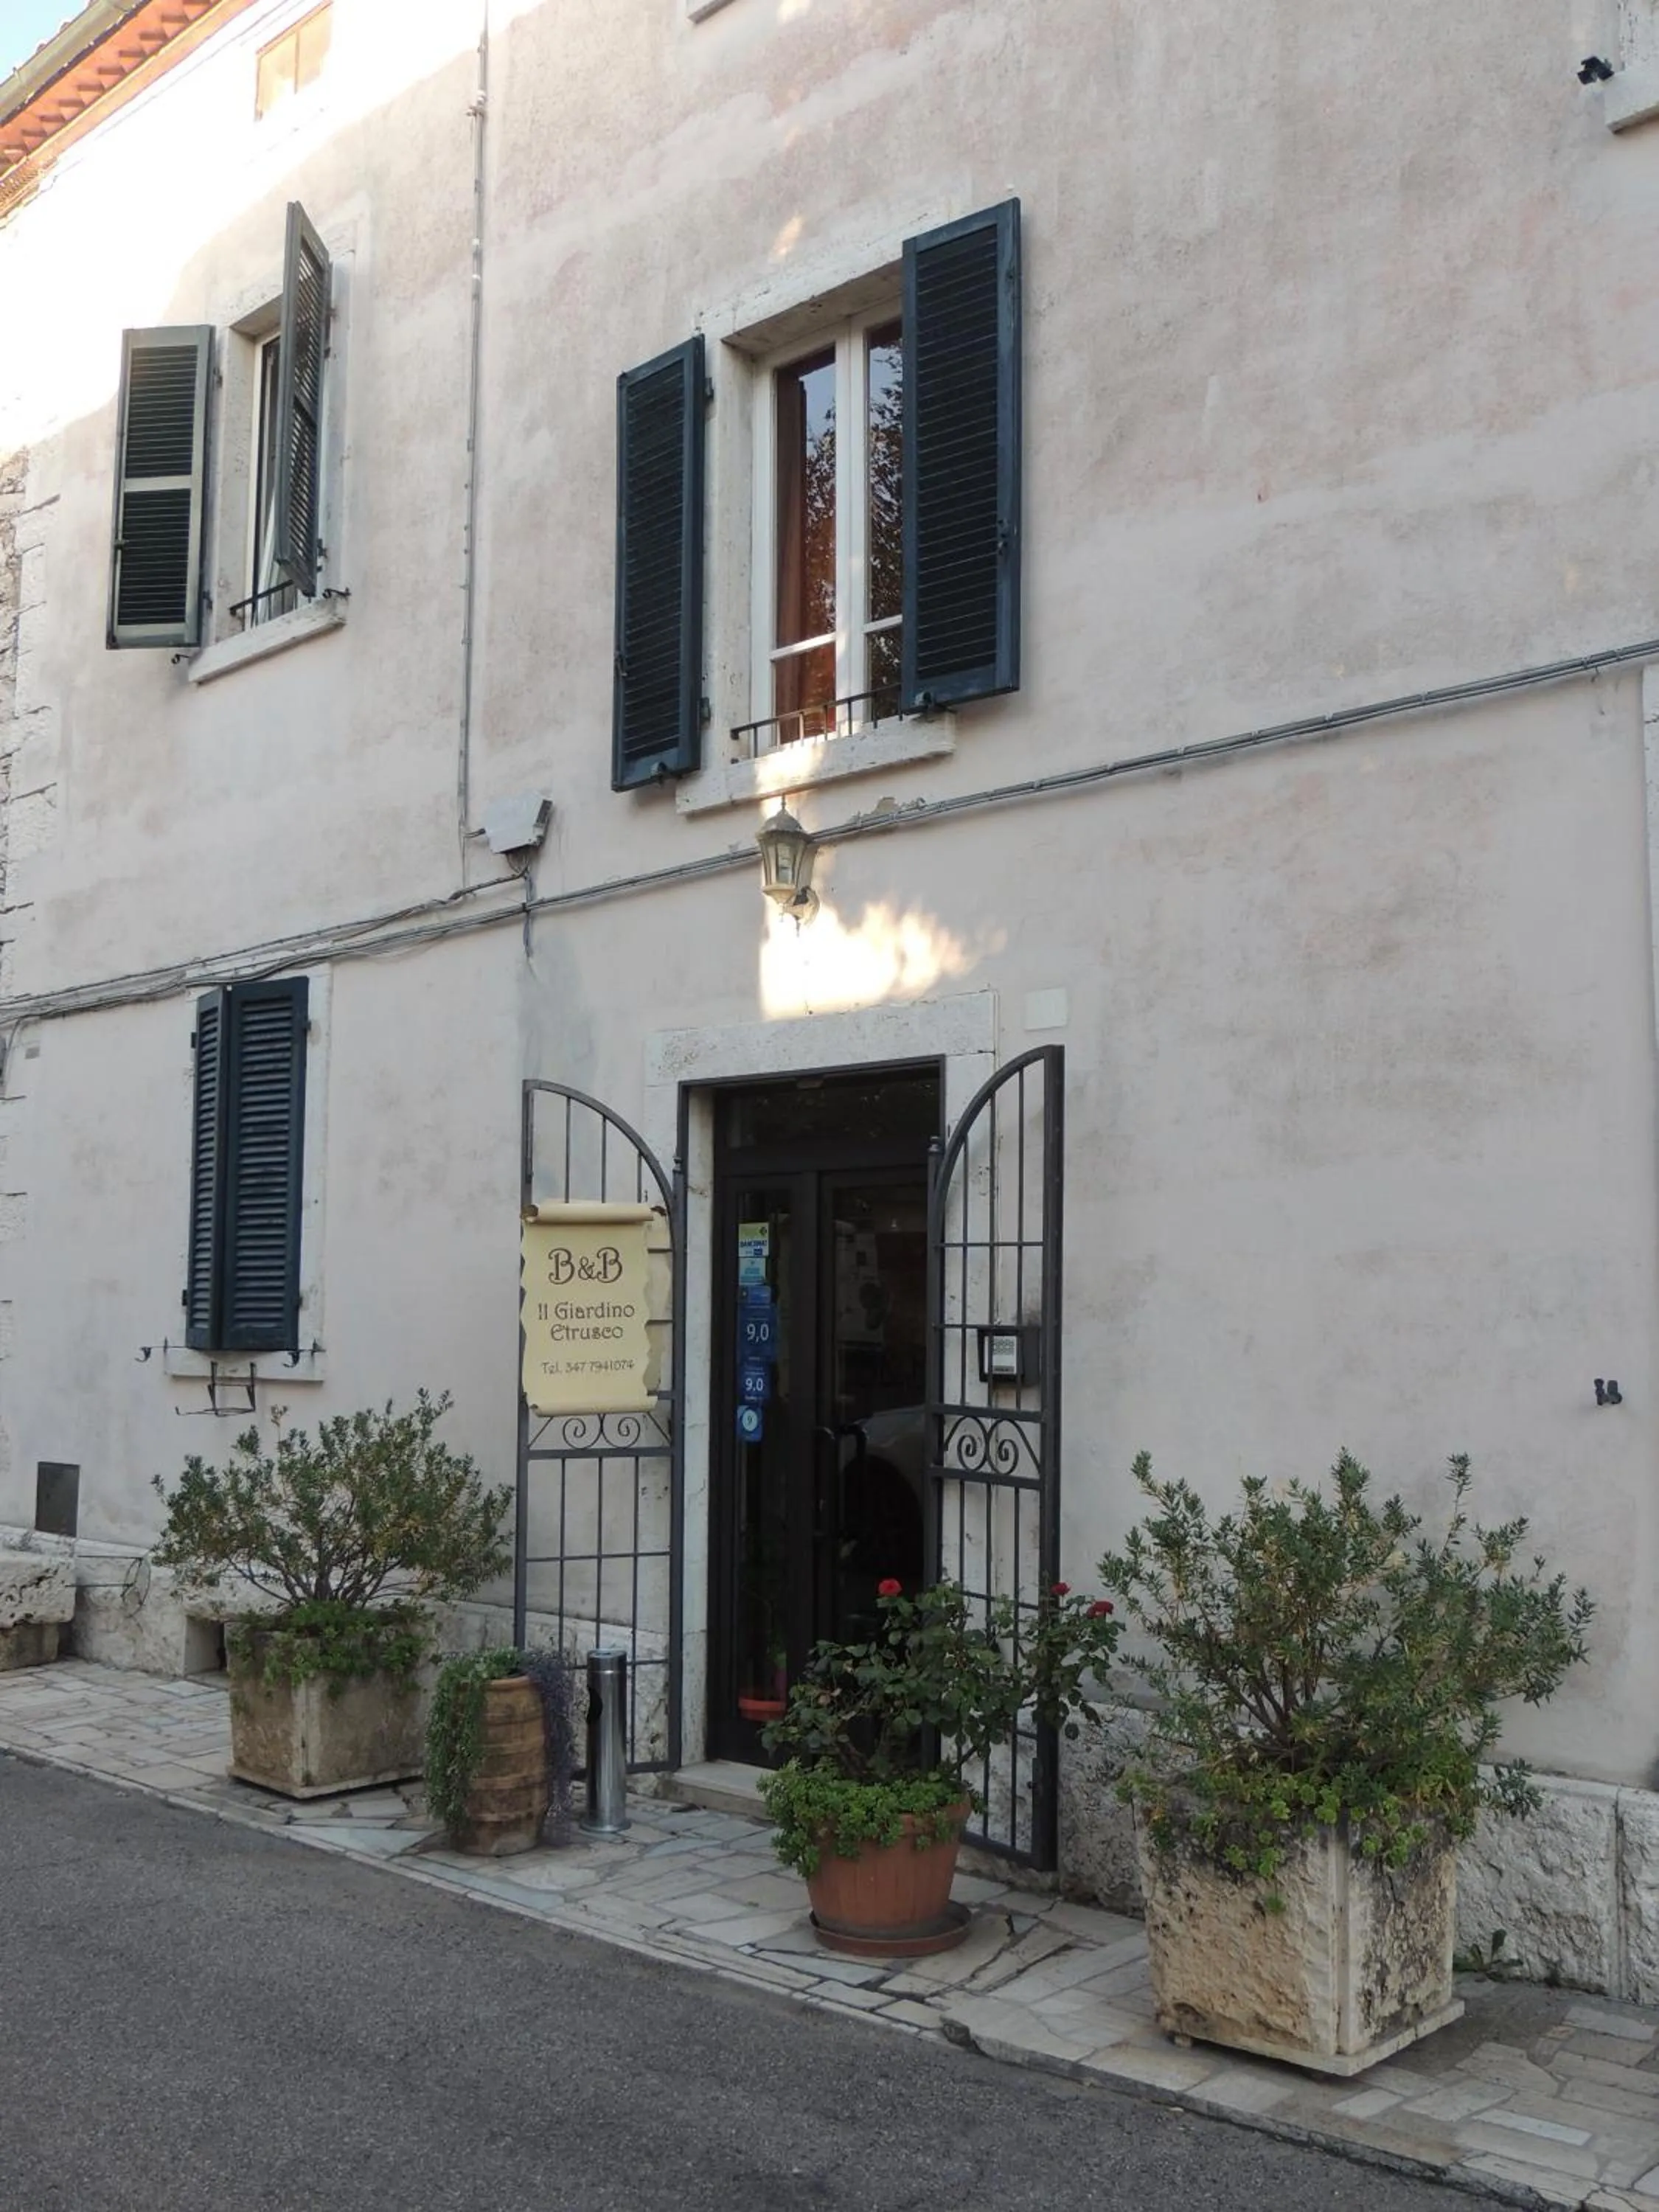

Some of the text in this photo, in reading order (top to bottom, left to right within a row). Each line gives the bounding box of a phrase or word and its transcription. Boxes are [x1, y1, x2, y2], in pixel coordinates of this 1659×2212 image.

[549, 1247, 622, 1284] B&B
[538, 1301, 635, 1321] Il Giardino
[550, 1324, 623, 1340] Etrusco
[747, 1324, 769, 1343] 9,0
[745, 1377, 764, 1391] 9.0
